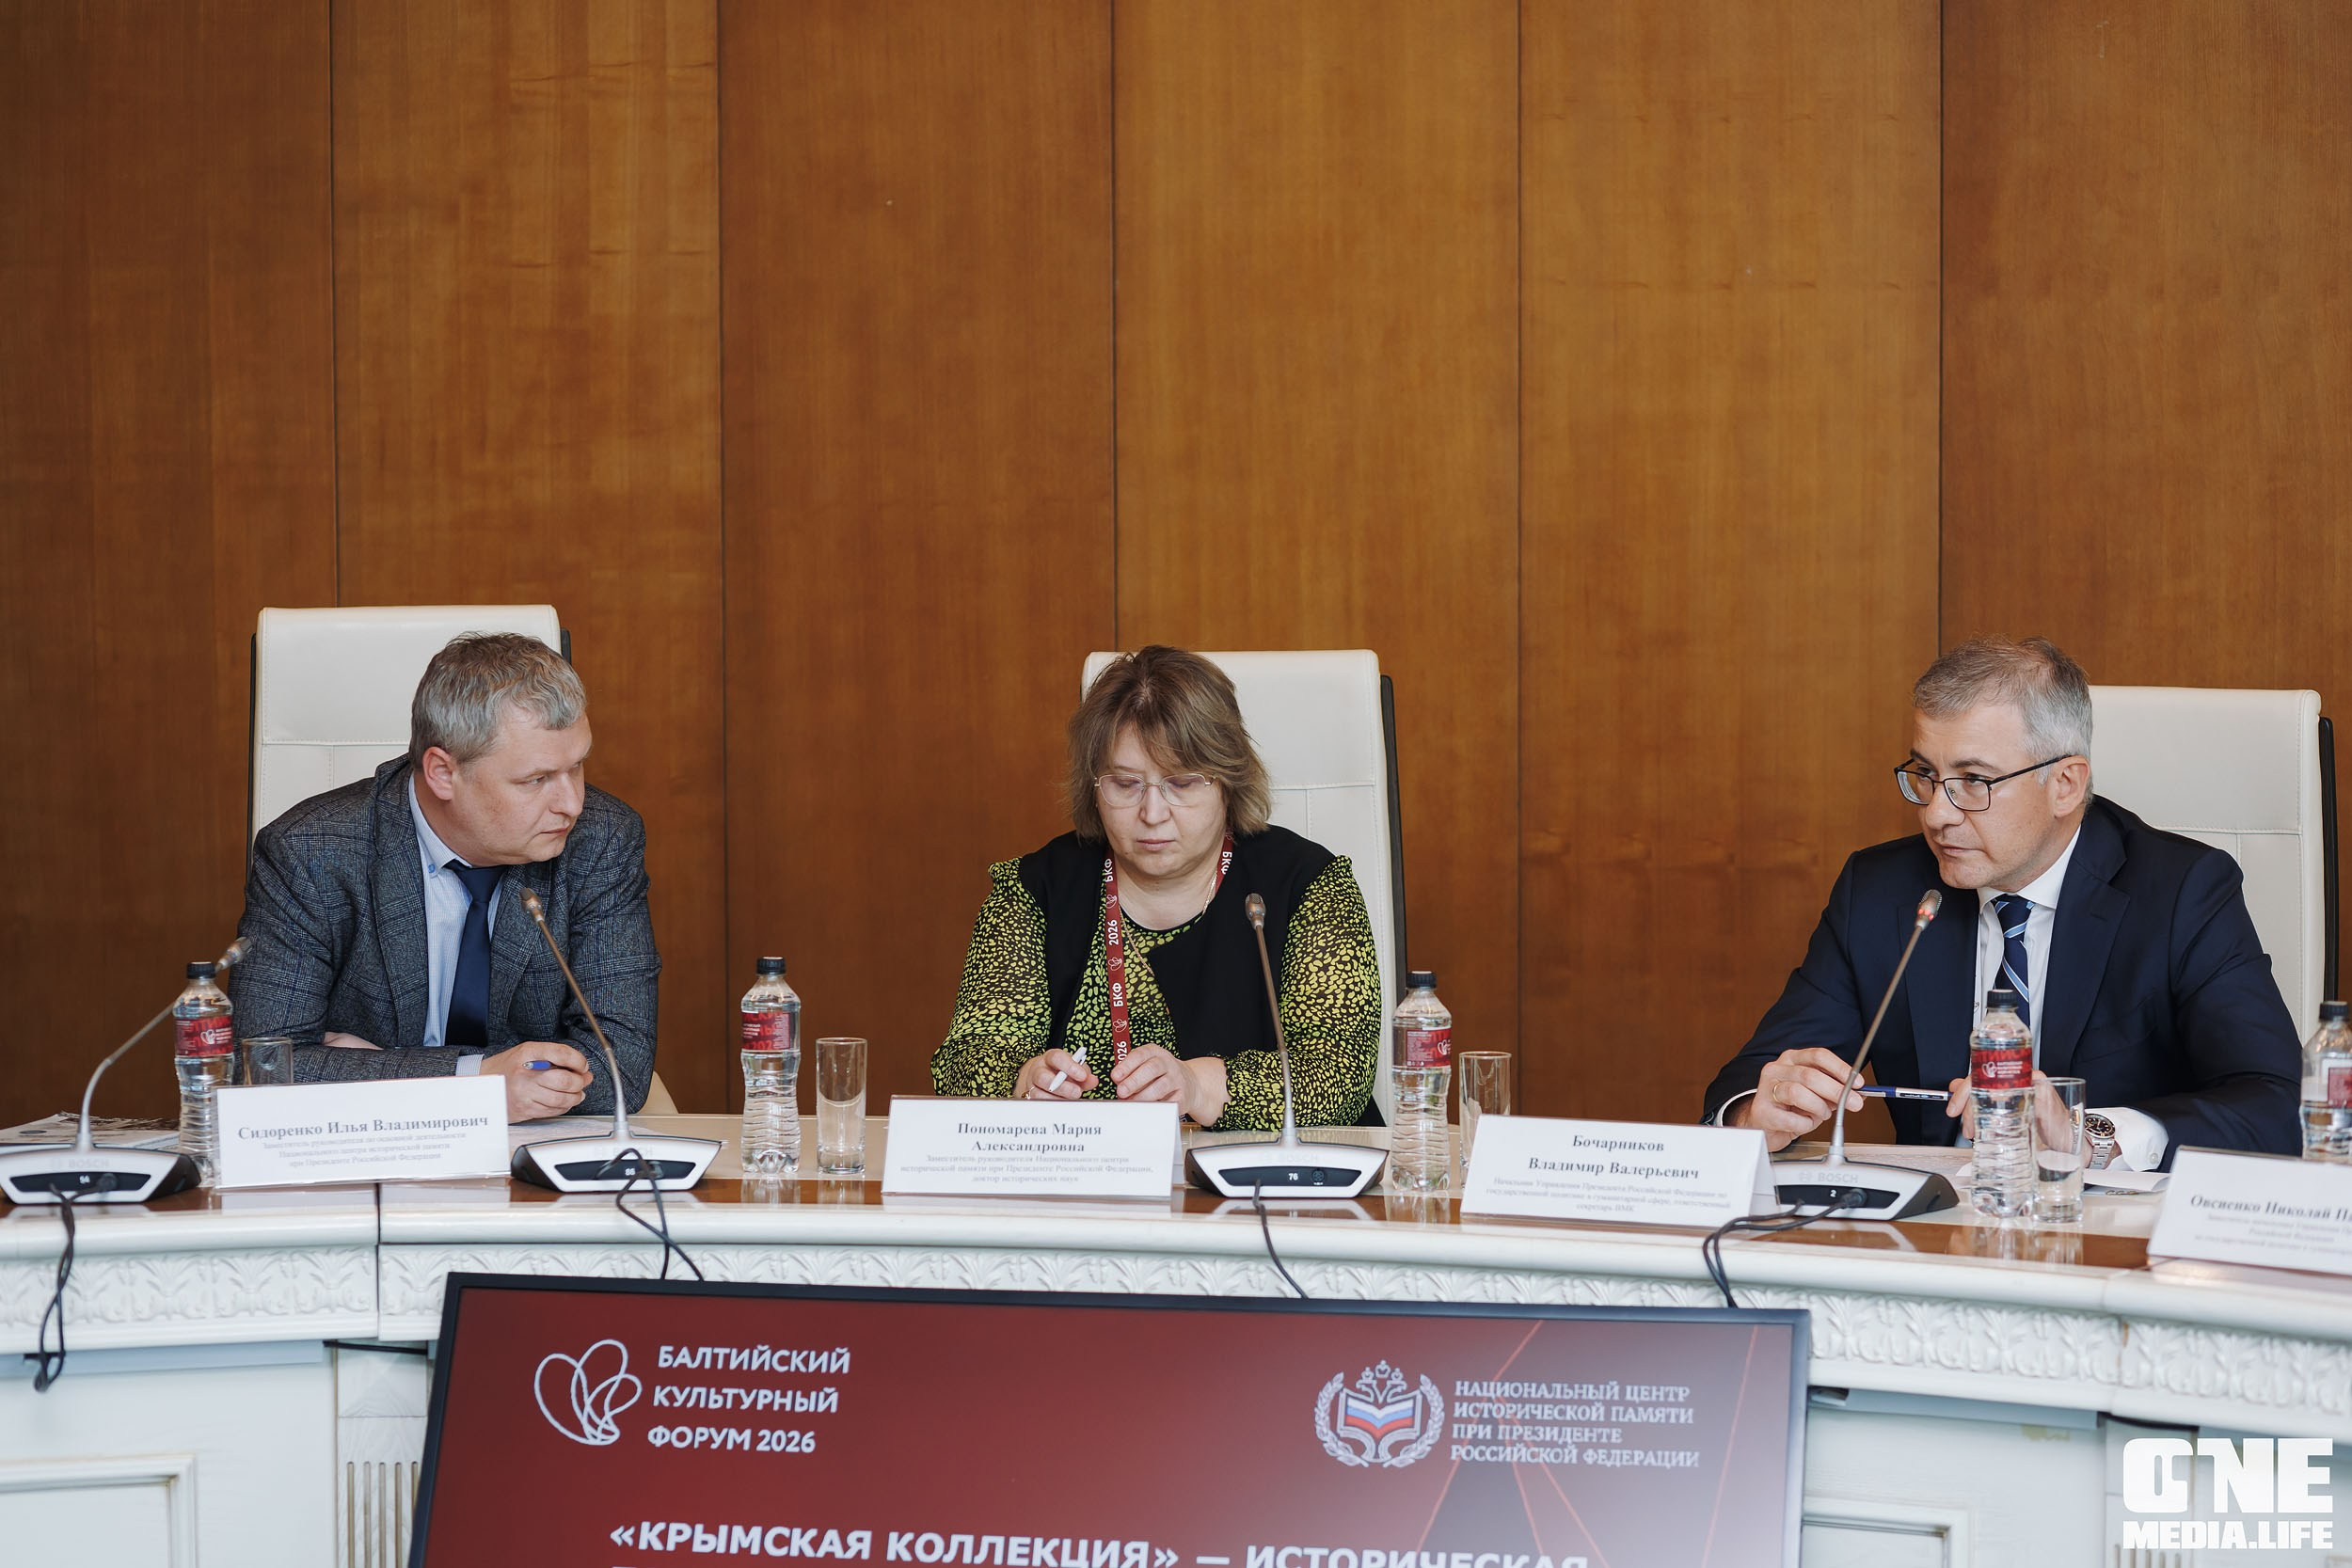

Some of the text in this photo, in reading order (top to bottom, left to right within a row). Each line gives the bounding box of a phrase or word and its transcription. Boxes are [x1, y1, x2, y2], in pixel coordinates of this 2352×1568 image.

[1107, 919, 1120, 946] 2026
[1112, 982, 1124, 1007] БКФ
[1117, 1040, 1128, 1064] 026
[238, 1117, 488, 1140] Сидоренко Илья Владимирович
[958, 1122, 1103, 1138] Пономарева Мария
[971, 1140, 1085, 1154] Александровна
[1572, 1134, 1665, 1152] Бочарников
[1288, 1172, 1299, 1180] 76
[1528, 1157, 1699, 1180] Владимир Валерьевич
[1818, 1172, 1858, 1183] BOSCH
[1830, 1189, 1837, 1197] 2
[2190, 1194, 2262, 1212] Овсиенко
[2265, 1201, 2331, 1220] Николай
[658, 1343, 851, 1374] БАЛТИЙСКИЙ
[653, 1385, 839, 1414] КУЛЬТУРНЫЙ
[1454, 1380, 1691, 1403] НАЦИОНАЛЬНЫЙ ЦЕНТР
[1453, 1401, 1694, 1424] ИСТОРИЧЕСКОЙ ПАМЯТИ
[647, 1424, 817, 1454] ФОРУМ 2026
[1452, 1423, 1624, 1445] ПРИ ПРЕЗИДЕНТЕ
[1450, 1443, 1701, 1469] РОССИЙСКОЙ ФЕДЕРАЦИИ
[610, 1521, 872, 1560] «КРЫМСКАЯ
[886, 1531, 1180, 1568] КОЛЛЕКЦИЯ»
